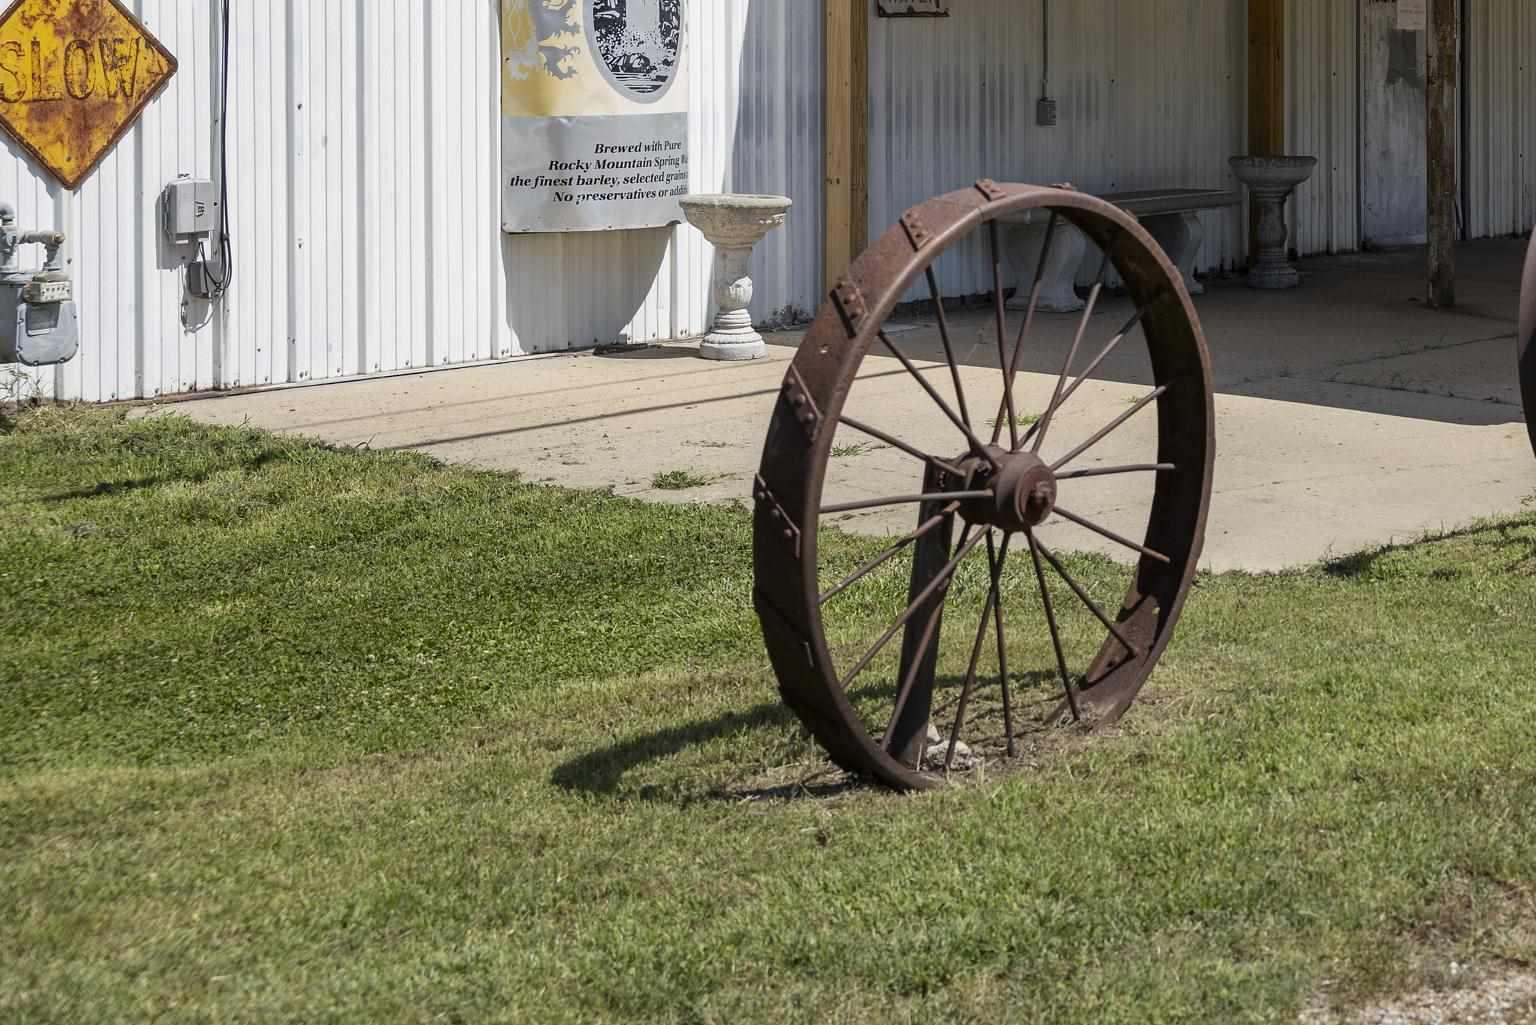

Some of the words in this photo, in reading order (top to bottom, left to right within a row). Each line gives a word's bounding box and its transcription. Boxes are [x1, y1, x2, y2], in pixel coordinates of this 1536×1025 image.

[0, 37, 142, 104] SLOW
[594, 142, 642, 154] Brewed
[644, 140, 663, 153] with
[664, 140, 682, 151] Pure
[548, 159, 592, 173] Rocky
[594, 157, 652, 170] Mountain
[654, 154, 680, 168] Spring
[510, 176, 531, 187] the
[531, 175, 574, 189] finest
[623, 171, 665, 185] selected
[553, 191, 574, 203] No
[575, 188, 657, 205] preservatives
[658, 189, 669, 198] or
